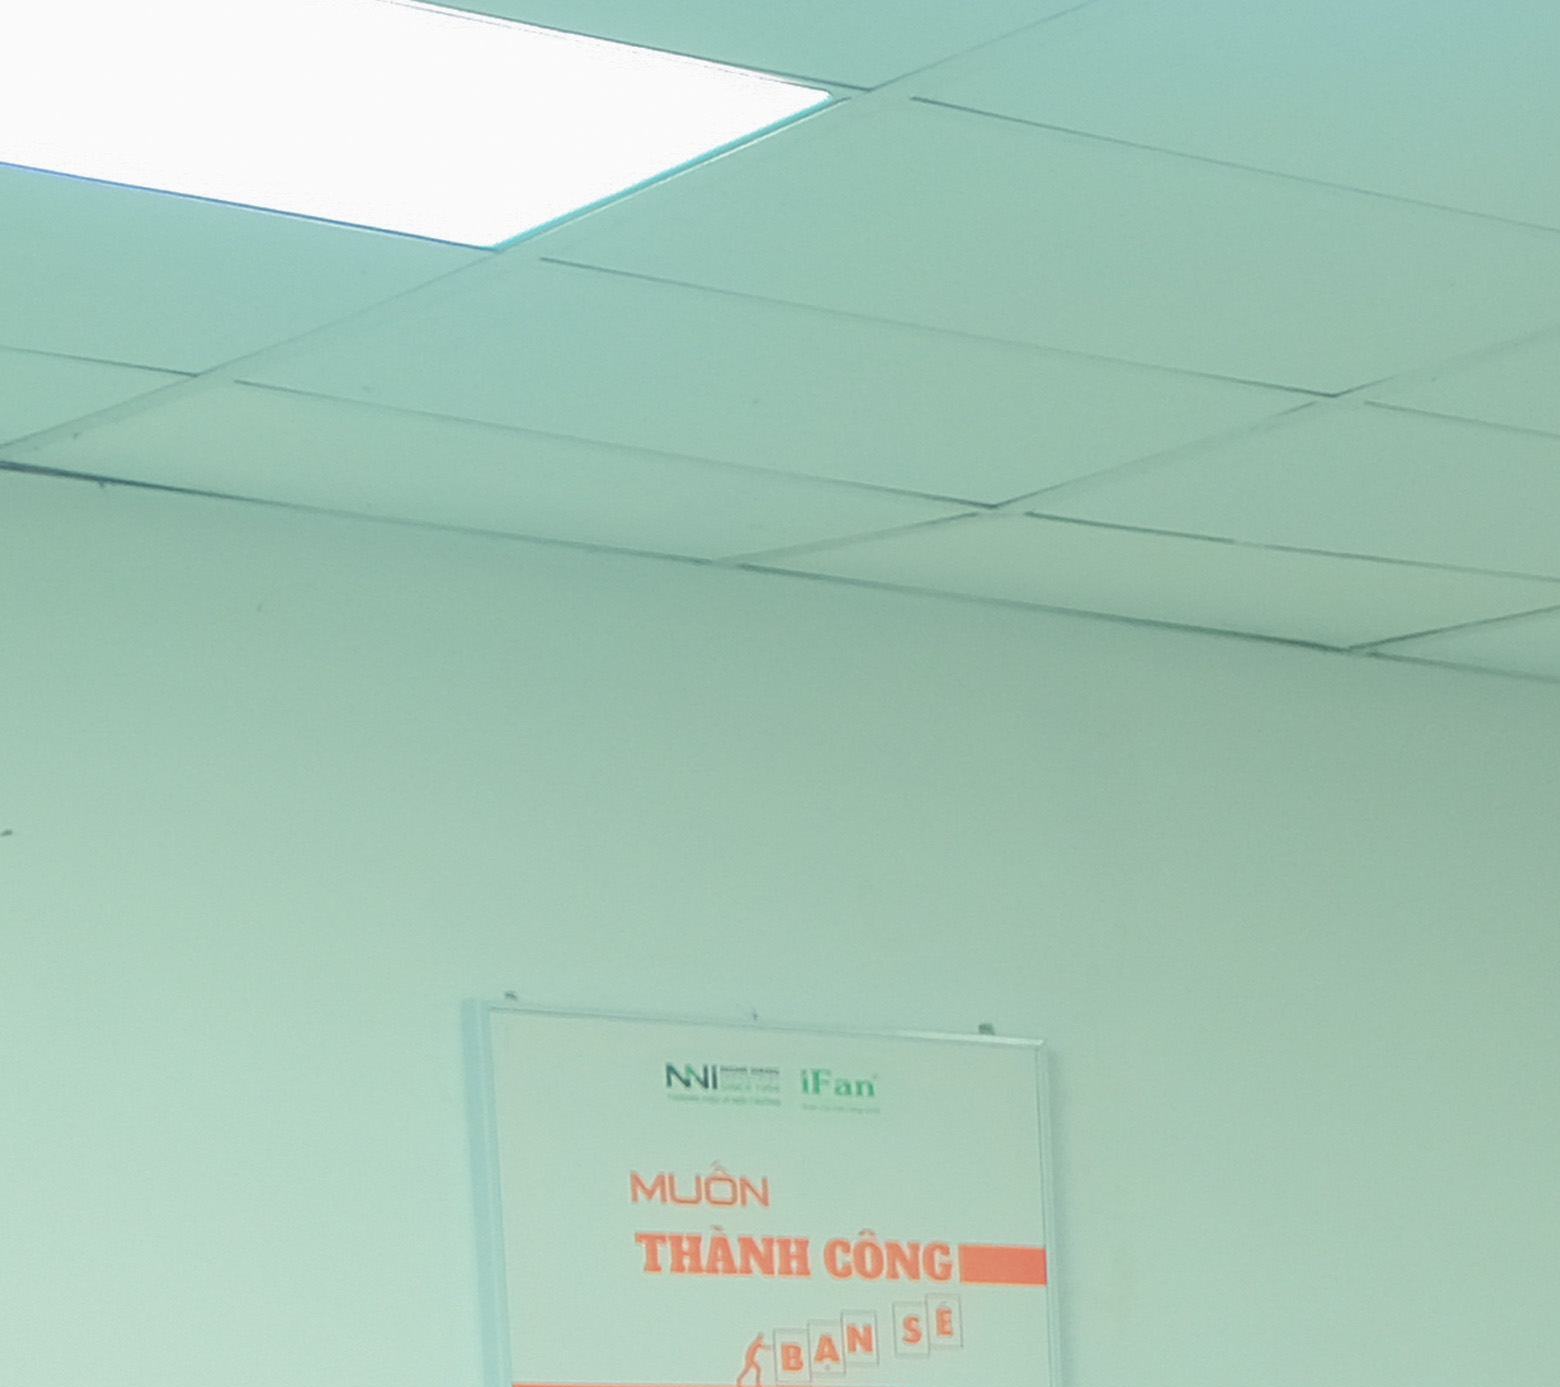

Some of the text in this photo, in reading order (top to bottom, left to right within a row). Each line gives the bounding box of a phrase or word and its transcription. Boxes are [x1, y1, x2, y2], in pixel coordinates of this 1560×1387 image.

[801, 1069, 874, 1097] iFan
[634, 1225, 954, 1281] THÀNH CÔNG
[781, 1324, 874, 1371] BẠN
